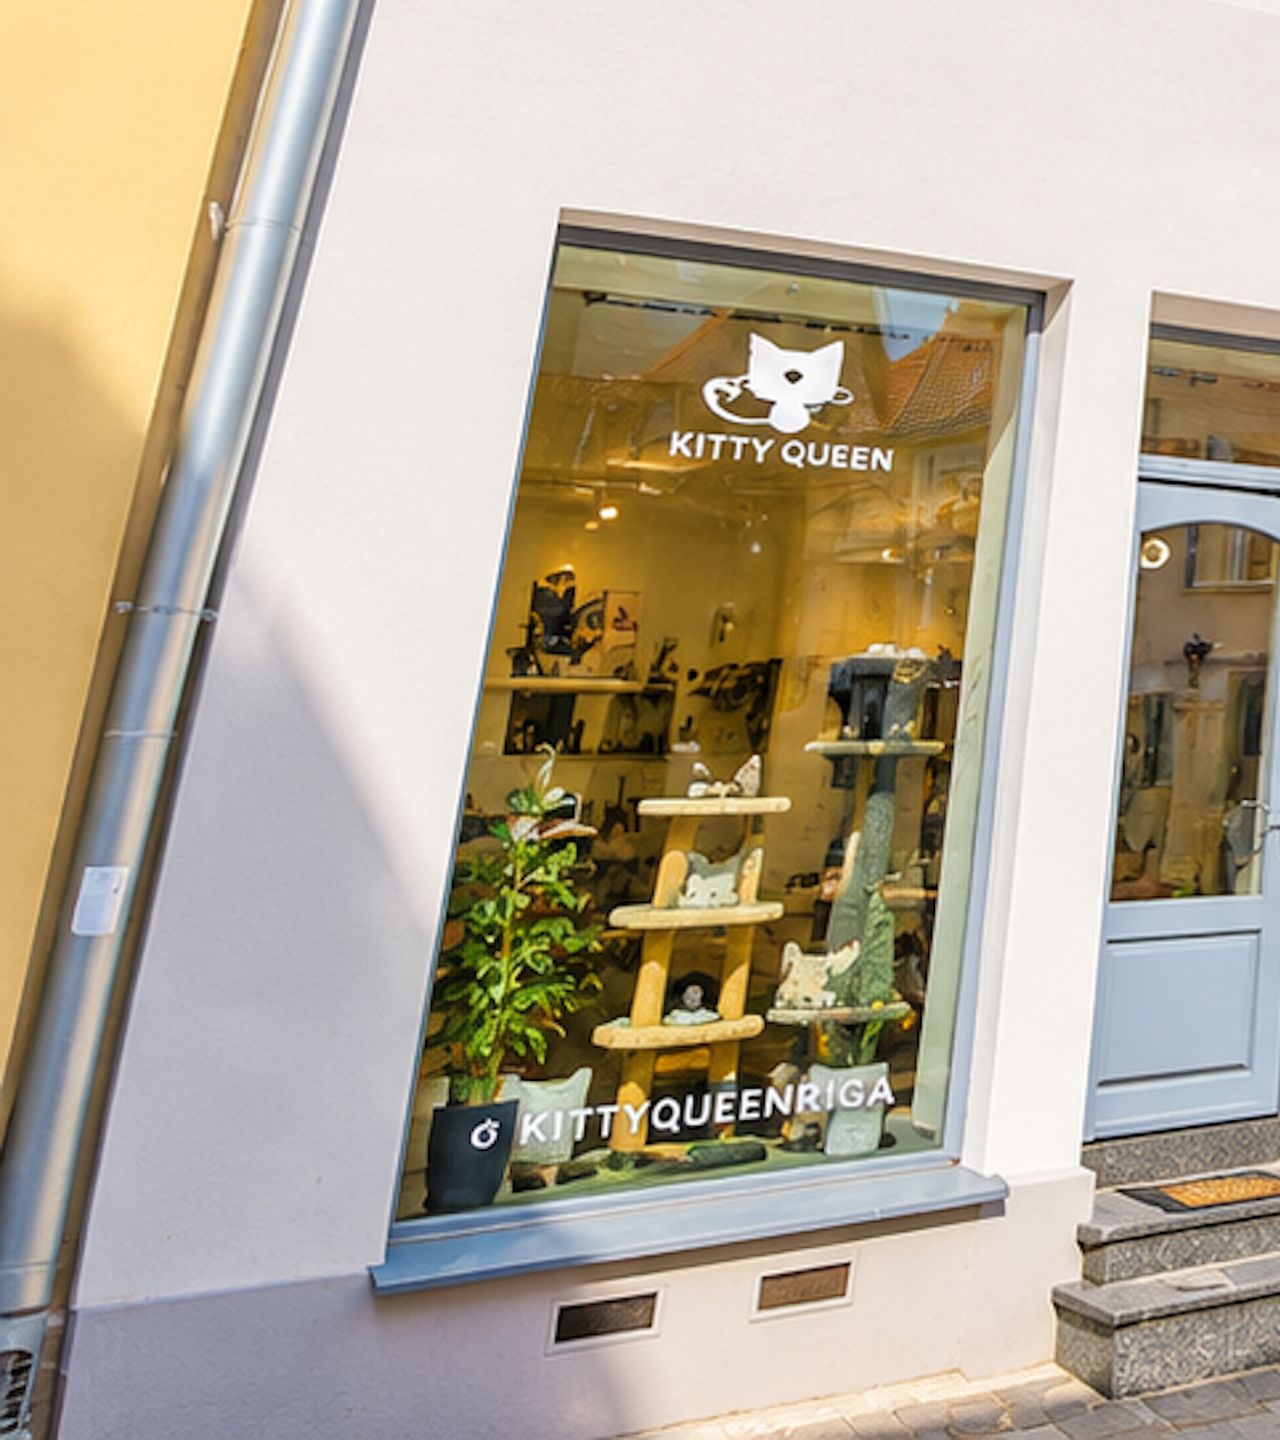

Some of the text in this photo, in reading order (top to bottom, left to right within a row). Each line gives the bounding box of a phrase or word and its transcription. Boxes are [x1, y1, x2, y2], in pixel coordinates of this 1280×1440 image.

[669, 431, 894, 472] KITTY QUEEN
[518, 1075, 897, 1146] KITTYQUEENRIGA
